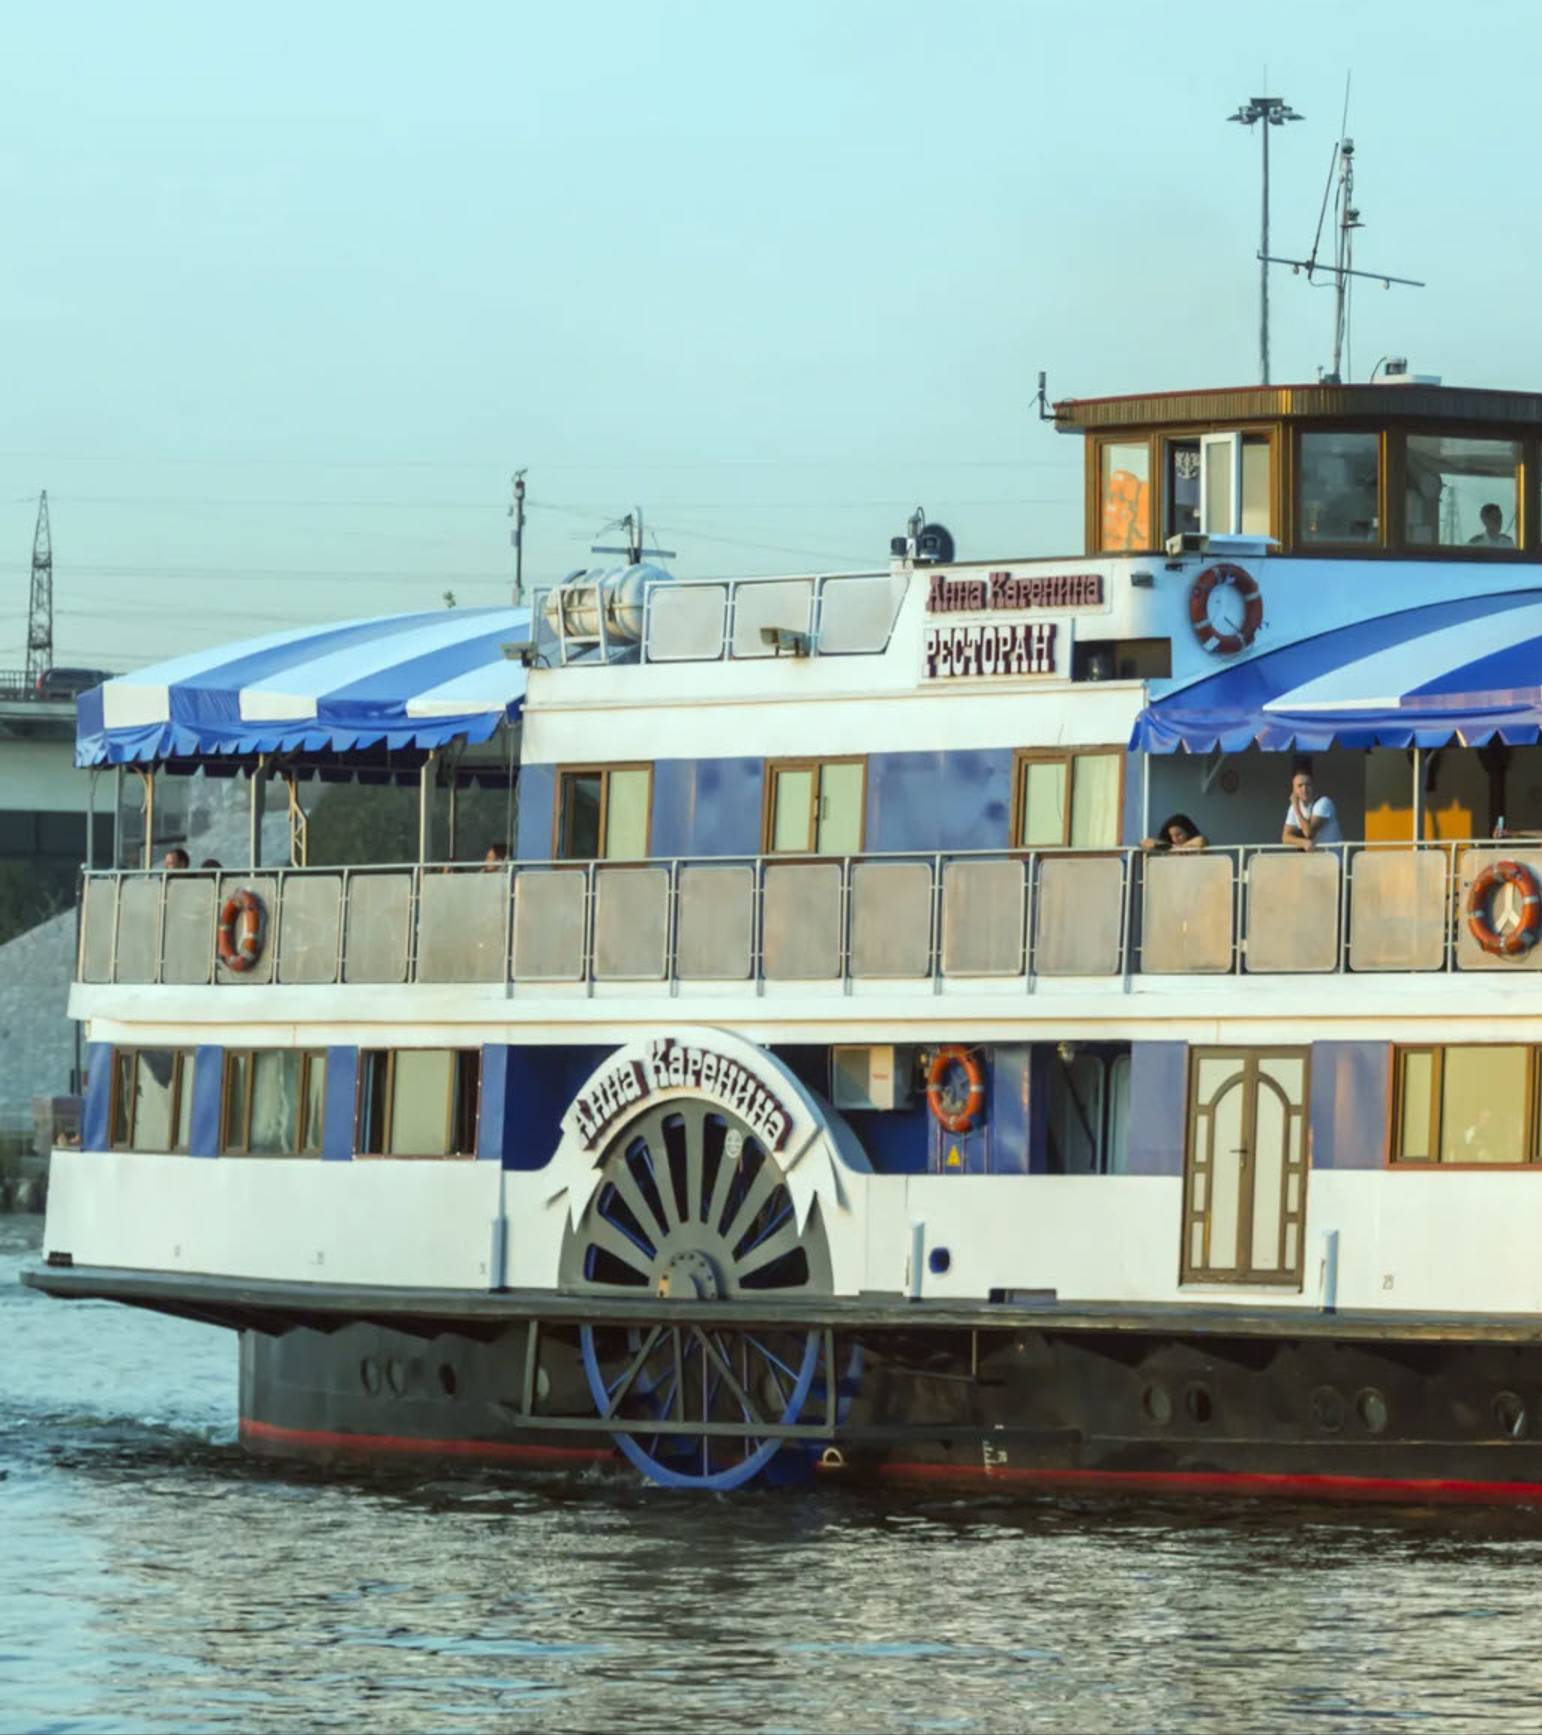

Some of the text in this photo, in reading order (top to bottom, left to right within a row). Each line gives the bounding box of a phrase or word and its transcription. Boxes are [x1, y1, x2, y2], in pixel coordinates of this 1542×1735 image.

[926, 571, 1103, 612] Анна Каренина
[924, 622, 1057, 678] РЕСТОРАН
[573, 1039, 793, 1151] Анна Каренина
